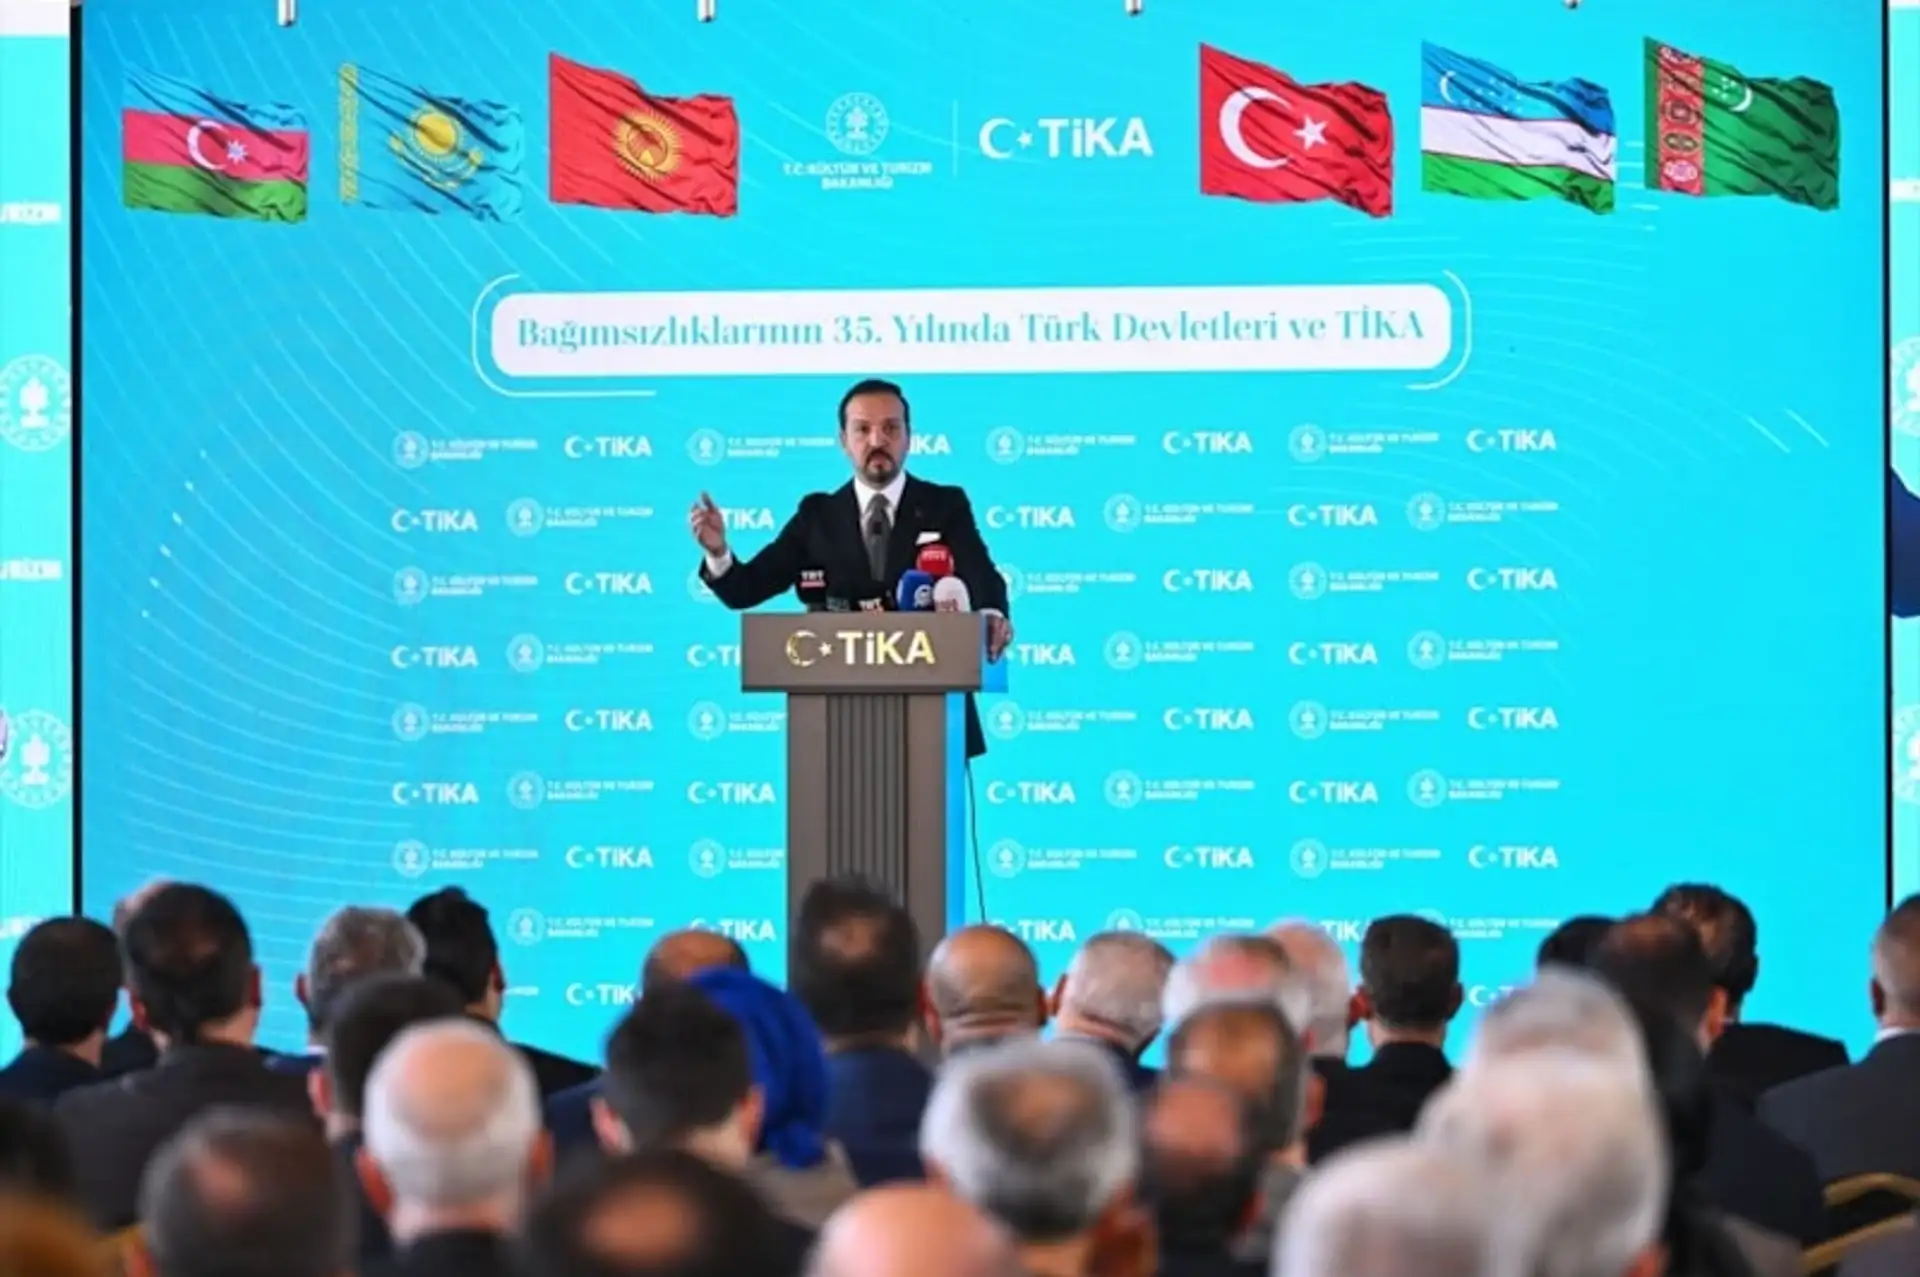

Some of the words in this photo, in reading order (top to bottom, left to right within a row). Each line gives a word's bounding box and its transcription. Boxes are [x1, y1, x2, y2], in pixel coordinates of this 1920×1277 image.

[833, 314, 883, 344] 35.
[892, 312, 1012, 344] Yılında
[1019, 311, 1102, 343] Türk
[1112, 310, 1278, 341] Devletleri
[1288, 318, 1327, 340] ve
